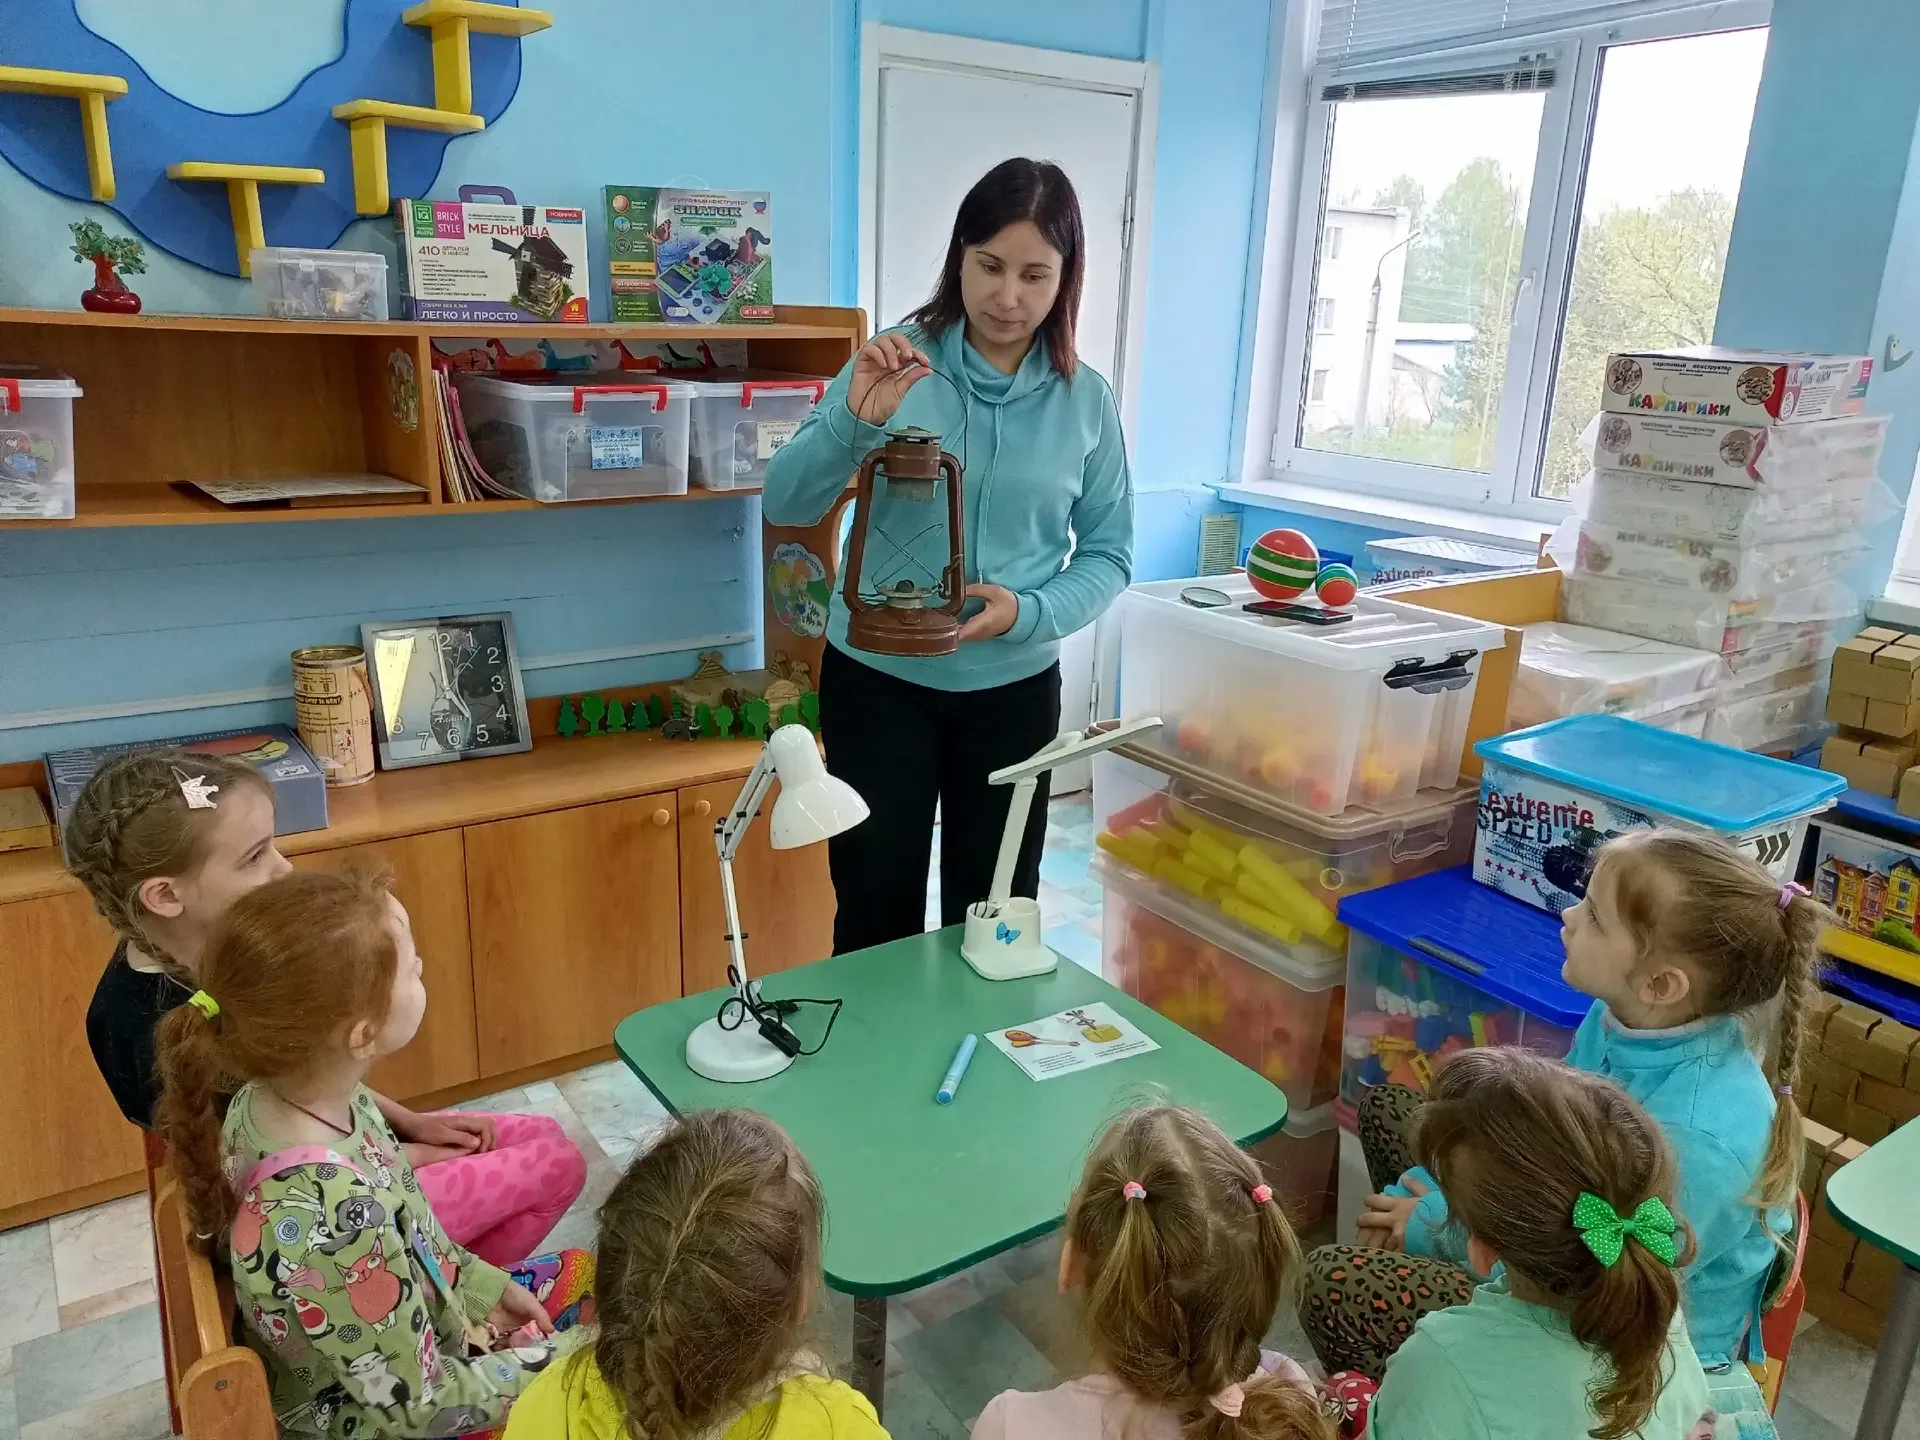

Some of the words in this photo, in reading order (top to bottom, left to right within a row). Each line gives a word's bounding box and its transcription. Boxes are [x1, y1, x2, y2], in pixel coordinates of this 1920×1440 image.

[436, 211, 460, 221] BRICK
[551, 210, 578, 218] НОВИНКА
[438, 223, 461, 233] STYLE
[468, 223, 550, 238] МЕЛЬНИЦА
[418, 245, 440, 256] 410
[421, 310, 458, 319] ЛЕГКО
[462, 311, 470, 319] И
[473, 311, 518, 320] ПРОСТО
[1628, 393, 1731, 417] КАРПИЧИКИ
[428, 632, 452, 650] 12
[466, 630, 475, 648] 1
[486, 646, 501, 664] 2
[490, 674, 504, 693] 3
[495, 703, 508, 721] 4
[389, 716, 404, 735] 8
[476, 724, 489, 742] 5
[416, 731, 431, 750] 7
[446, 728, 461, 746] 6
[1487, 791, 1595, 830] extreme
